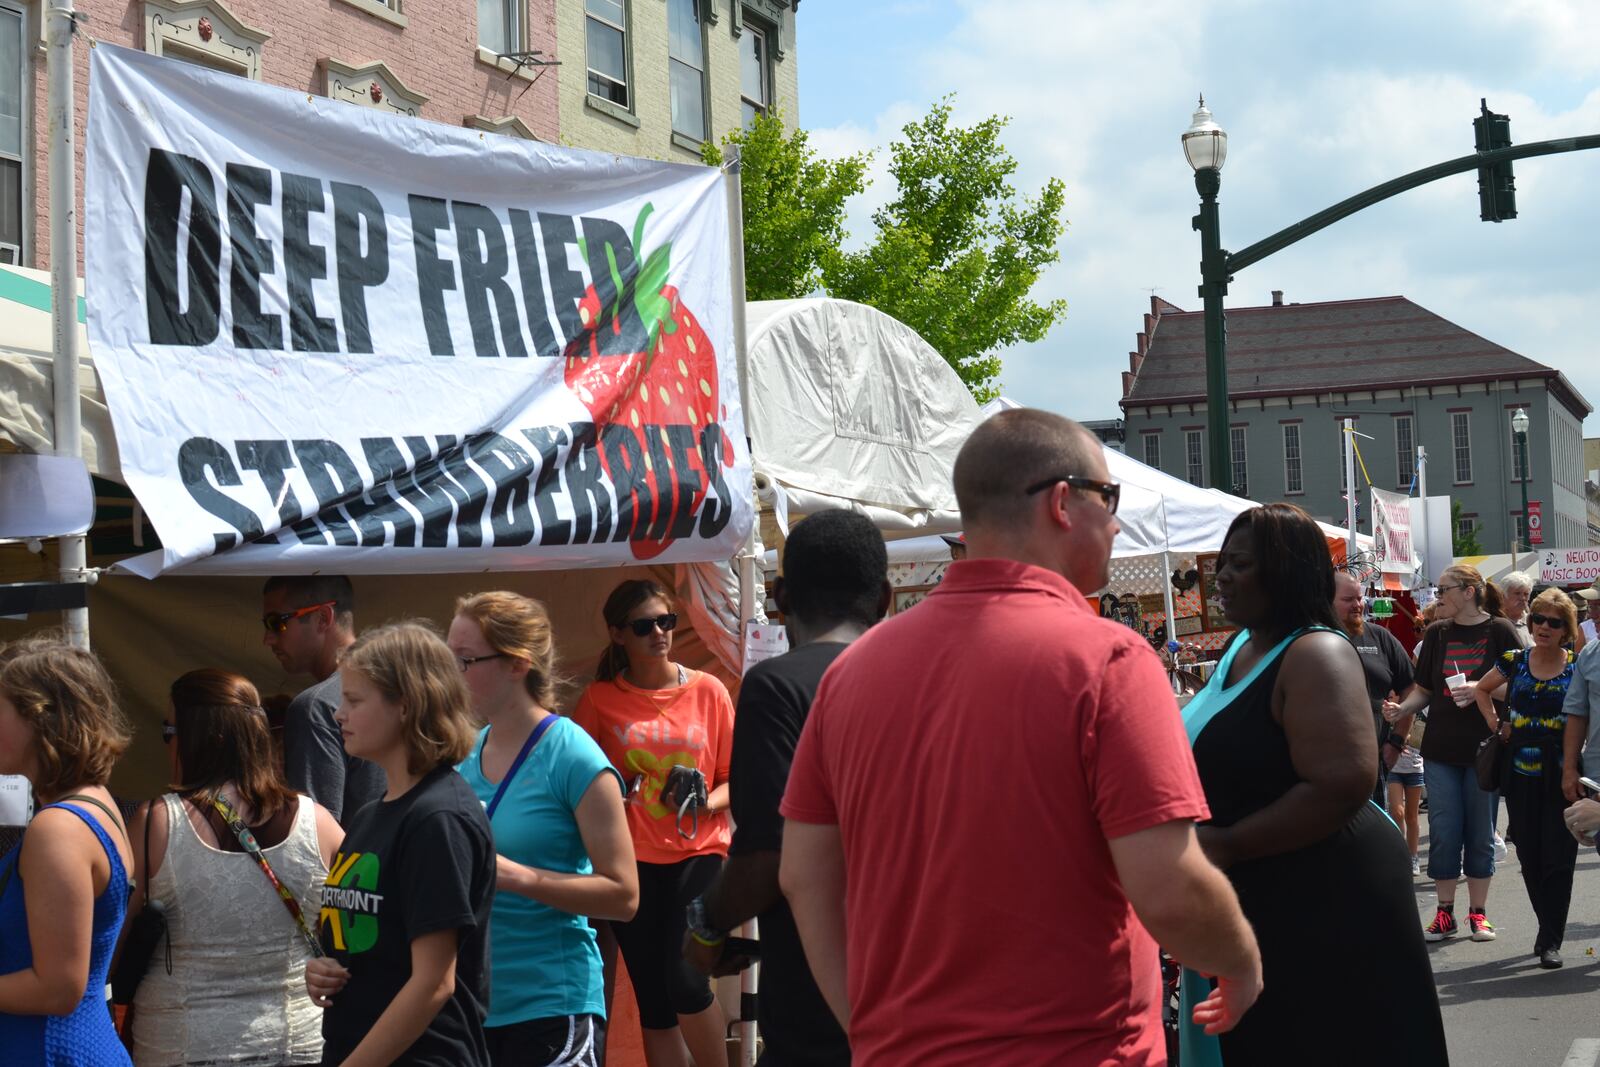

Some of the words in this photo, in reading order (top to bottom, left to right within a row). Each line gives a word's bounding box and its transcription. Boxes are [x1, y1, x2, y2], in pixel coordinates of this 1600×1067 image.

[145, 148, 389, 354] DEEP
[408, 194, 648, 358] FRIED
[178, 421, 732, 555] STRAWBERRIES
[1566, 550, 1600, 564] NEWTO
[1542, 568, 1573, 582] MUSIC
[1576, 567, 1600, 579] BOO
[321, 887, 384, 914] ORTHMONT
